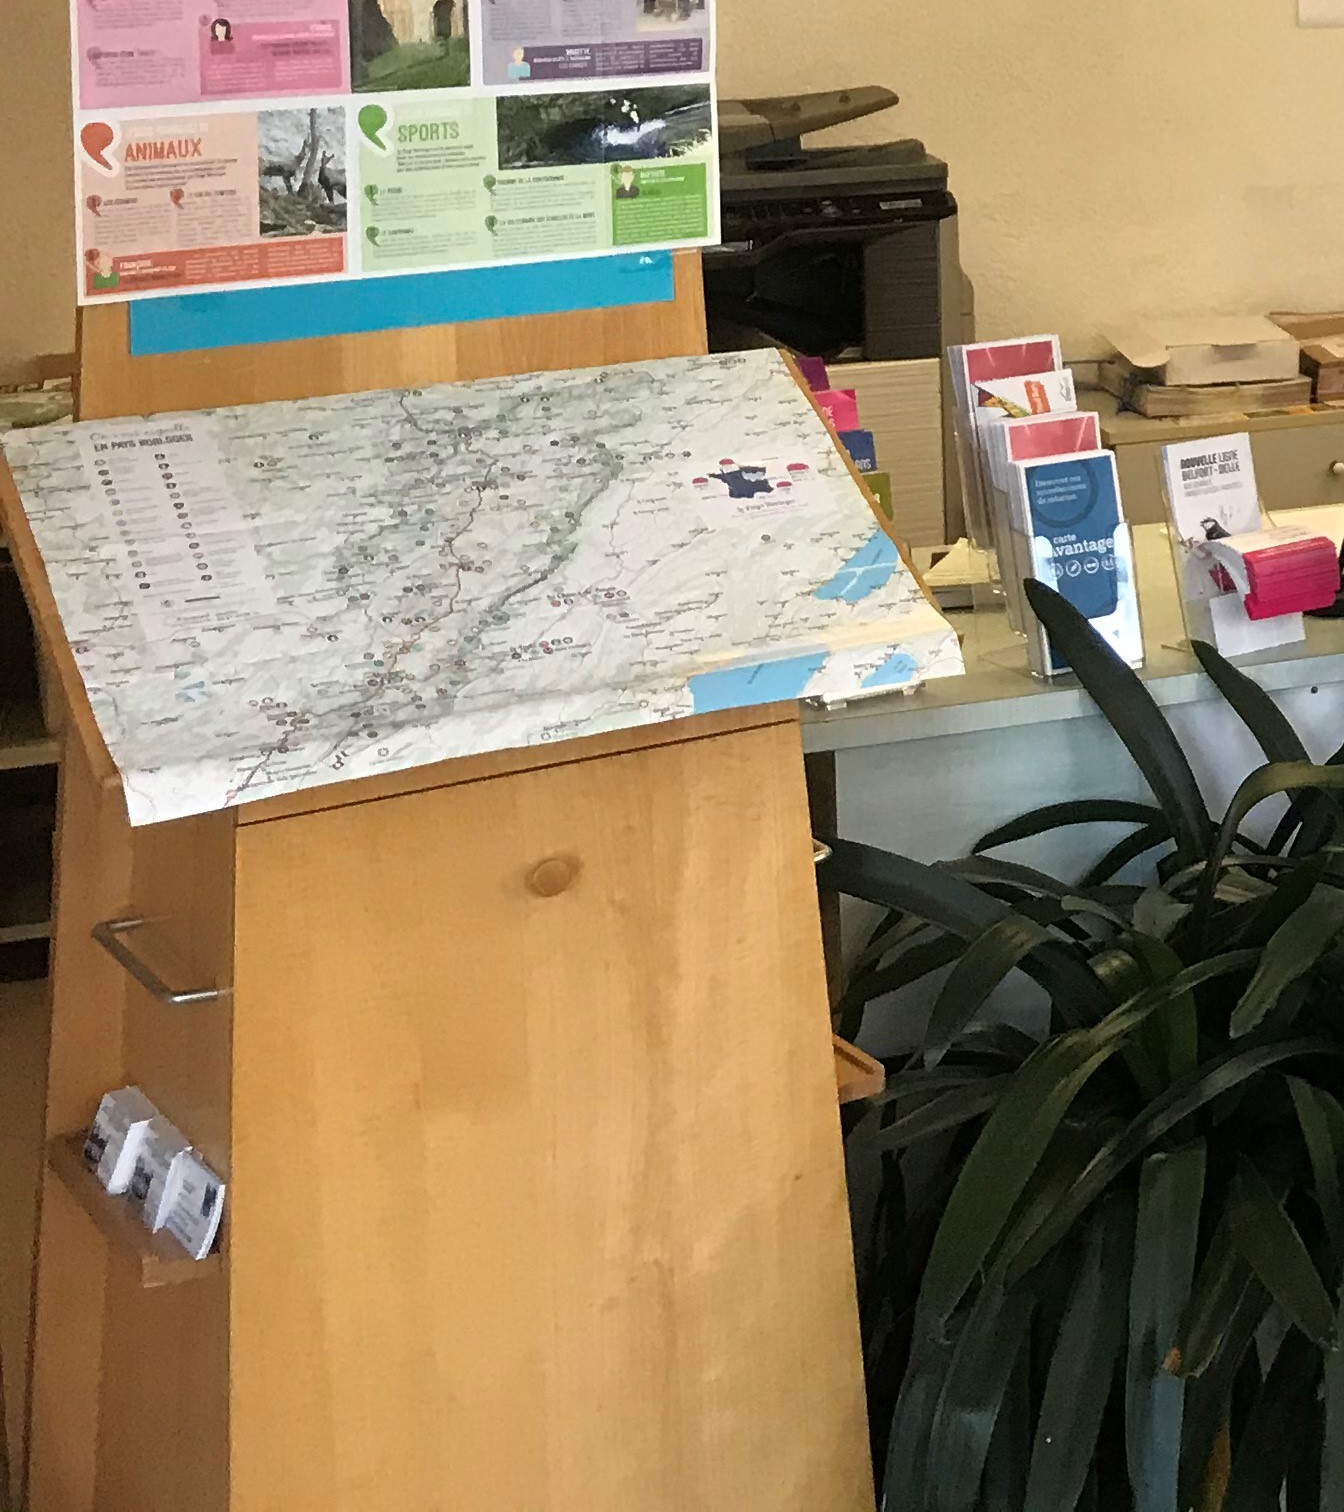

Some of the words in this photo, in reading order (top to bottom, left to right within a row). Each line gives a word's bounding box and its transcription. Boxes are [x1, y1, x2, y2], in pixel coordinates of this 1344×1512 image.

[397, 121, 460, 144] SPORTS
[124, 138, 203, 162] ANIMAUX
[1052, 537, 1115, 558] vantage
[1053, 534, 1077, 544] carte
